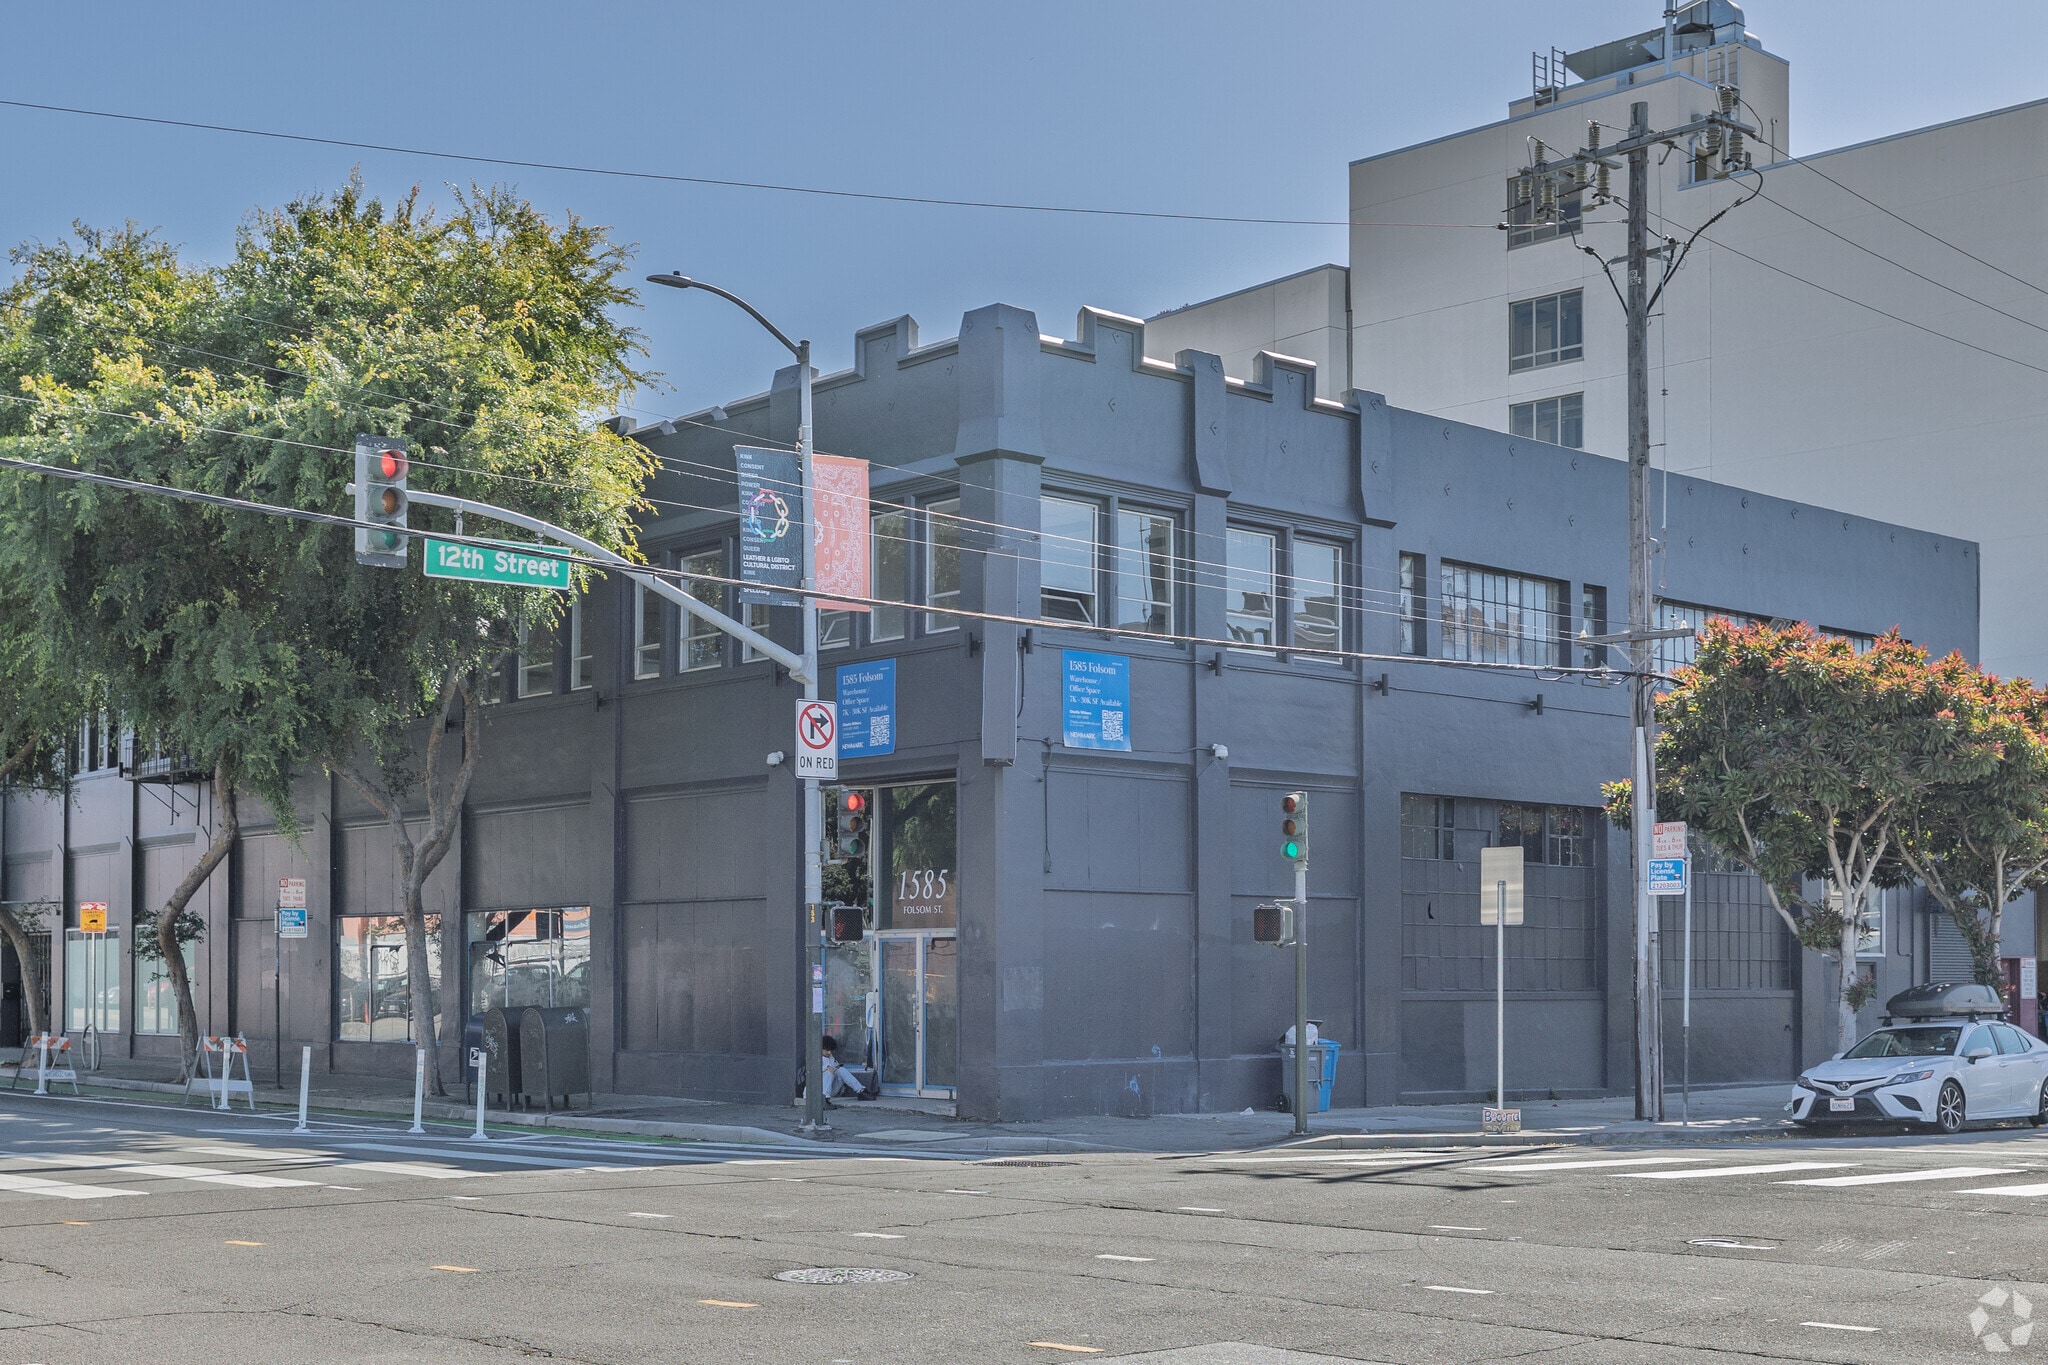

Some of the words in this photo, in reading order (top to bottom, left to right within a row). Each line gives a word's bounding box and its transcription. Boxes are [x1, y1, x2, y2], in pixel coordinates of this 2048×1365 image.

[740, 463, 765, 471] CONSENT
[741, 481, 760, 489] POWER
[439, 545, 484, 571] 12th
[494, 551, 559, 578] Street
[743, 554, 766, 562] LEATHER
[743, 561, 770, 570] CULTURAL
[1070, 660, 1087, 672] 1585
[1088, 662, 1117, 675] Folsom
[843, 674, 858, 686] 1585
[859, 672, 884, 683] Folsom
[1069, 675, 1098, 685] Warehouse
[843, 688, 868, 696] Warehouse
[1069, 684, 1086, 693] Office
[1086, 686, 1101, 696] Space
[842, 698, 856, 706] Office
[857, 697, 870, 706] Space
[1100, 699, 1123, 708] Available
[869, 704, 889, 713] Available
[1070, 731, 1096, 740] NEWMARK
[842, 742, 865, 750] NEWMARK
[800, 756, 813, 769] ON
[817, 757, 834, 770] RED
[1654, 824, 1663, 835] NO
[1665, 825, 1684, 833] PARKING
[898, 869, 949, 900] 1585
[904, 905, 932, 915] FOLSOM
[934, 905, 944, 914] ST.
